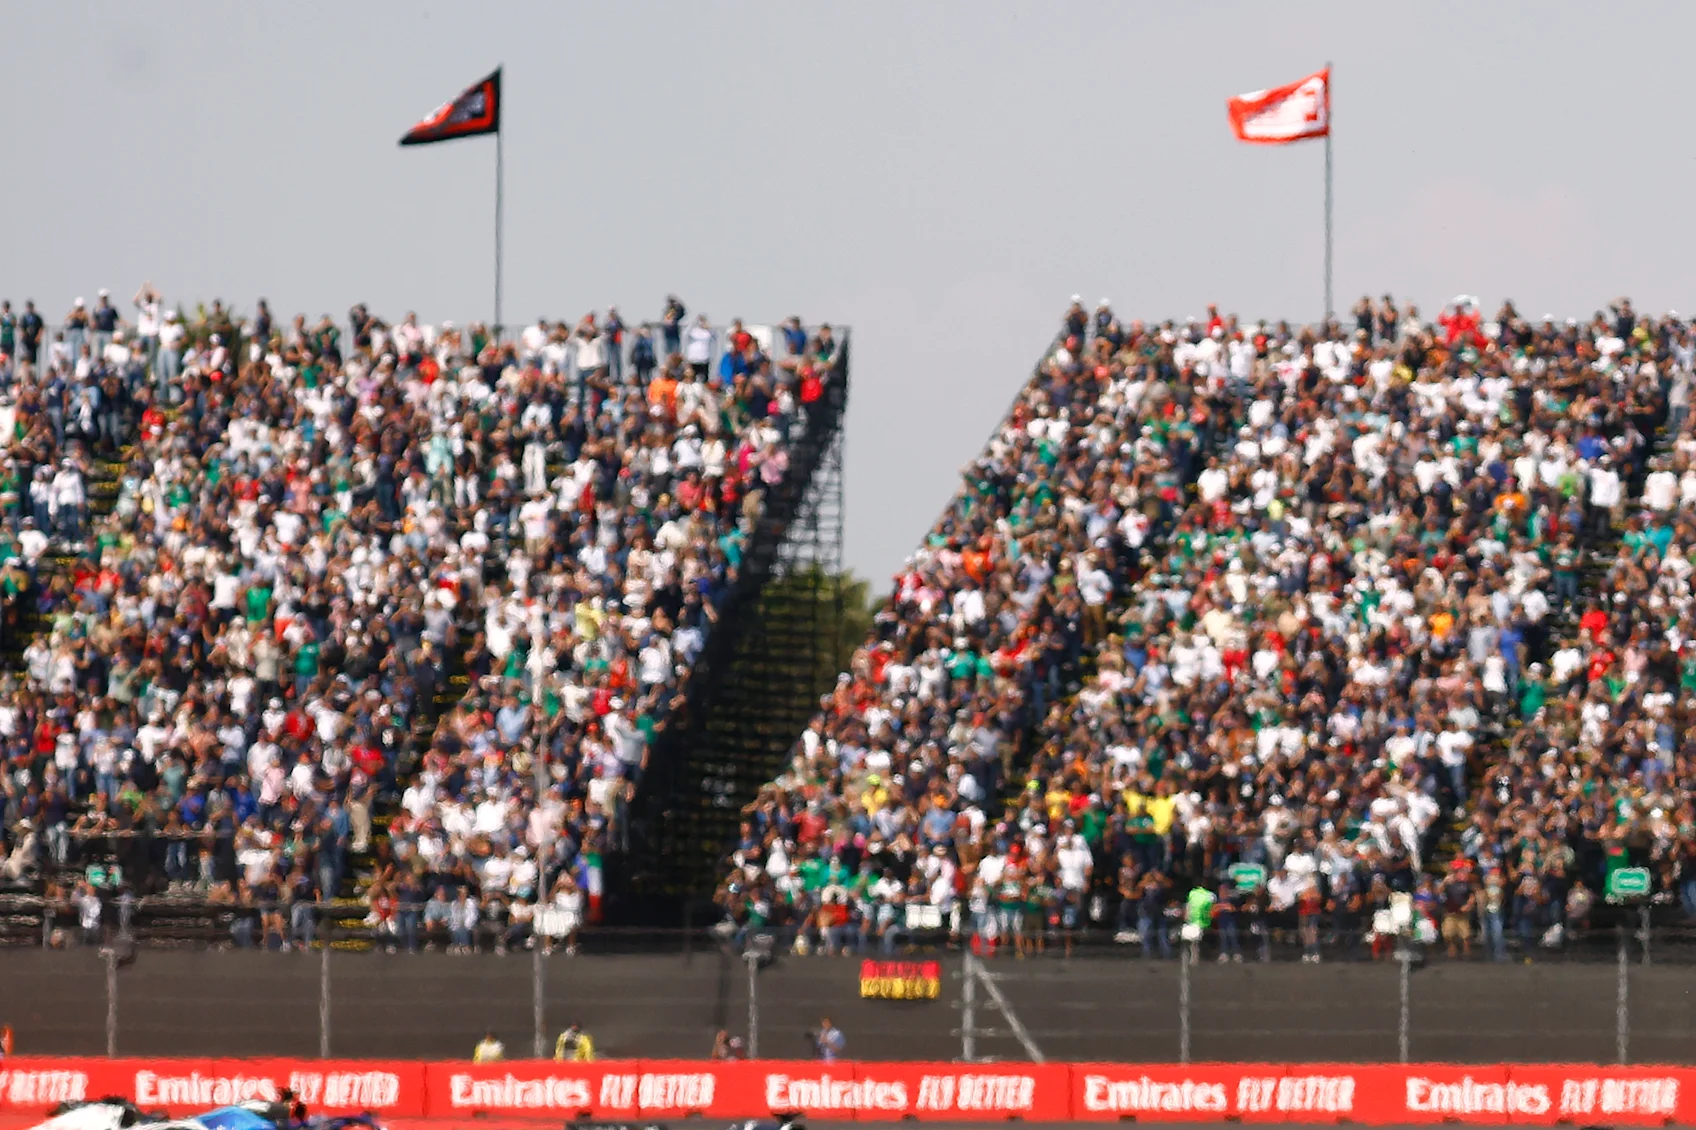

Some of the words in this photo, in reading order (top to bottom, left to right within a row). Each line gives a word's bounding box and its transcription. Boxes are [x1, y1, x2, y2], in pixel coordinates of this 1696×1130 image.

[136, 1070, 276, 1104] Emirates
[451, 1073, 590, 1107] Emirates
[600, 1073, 637, 1107] FLY
[639, 1073, 713, 1107] BETTER
[766, 1074, 907, 1109] Emirates
[917, 1074, 956, 1110] FLY
[958, 1074, 1034, 1110] BETTER
[1085, 1075, 1226, 1110] Emirates
[1237, 1076, 1274, 1111] FLY
[1276, 1076, 1354, 1111] BETTER
[1406, 1076, 1551, 1114] Emirates
